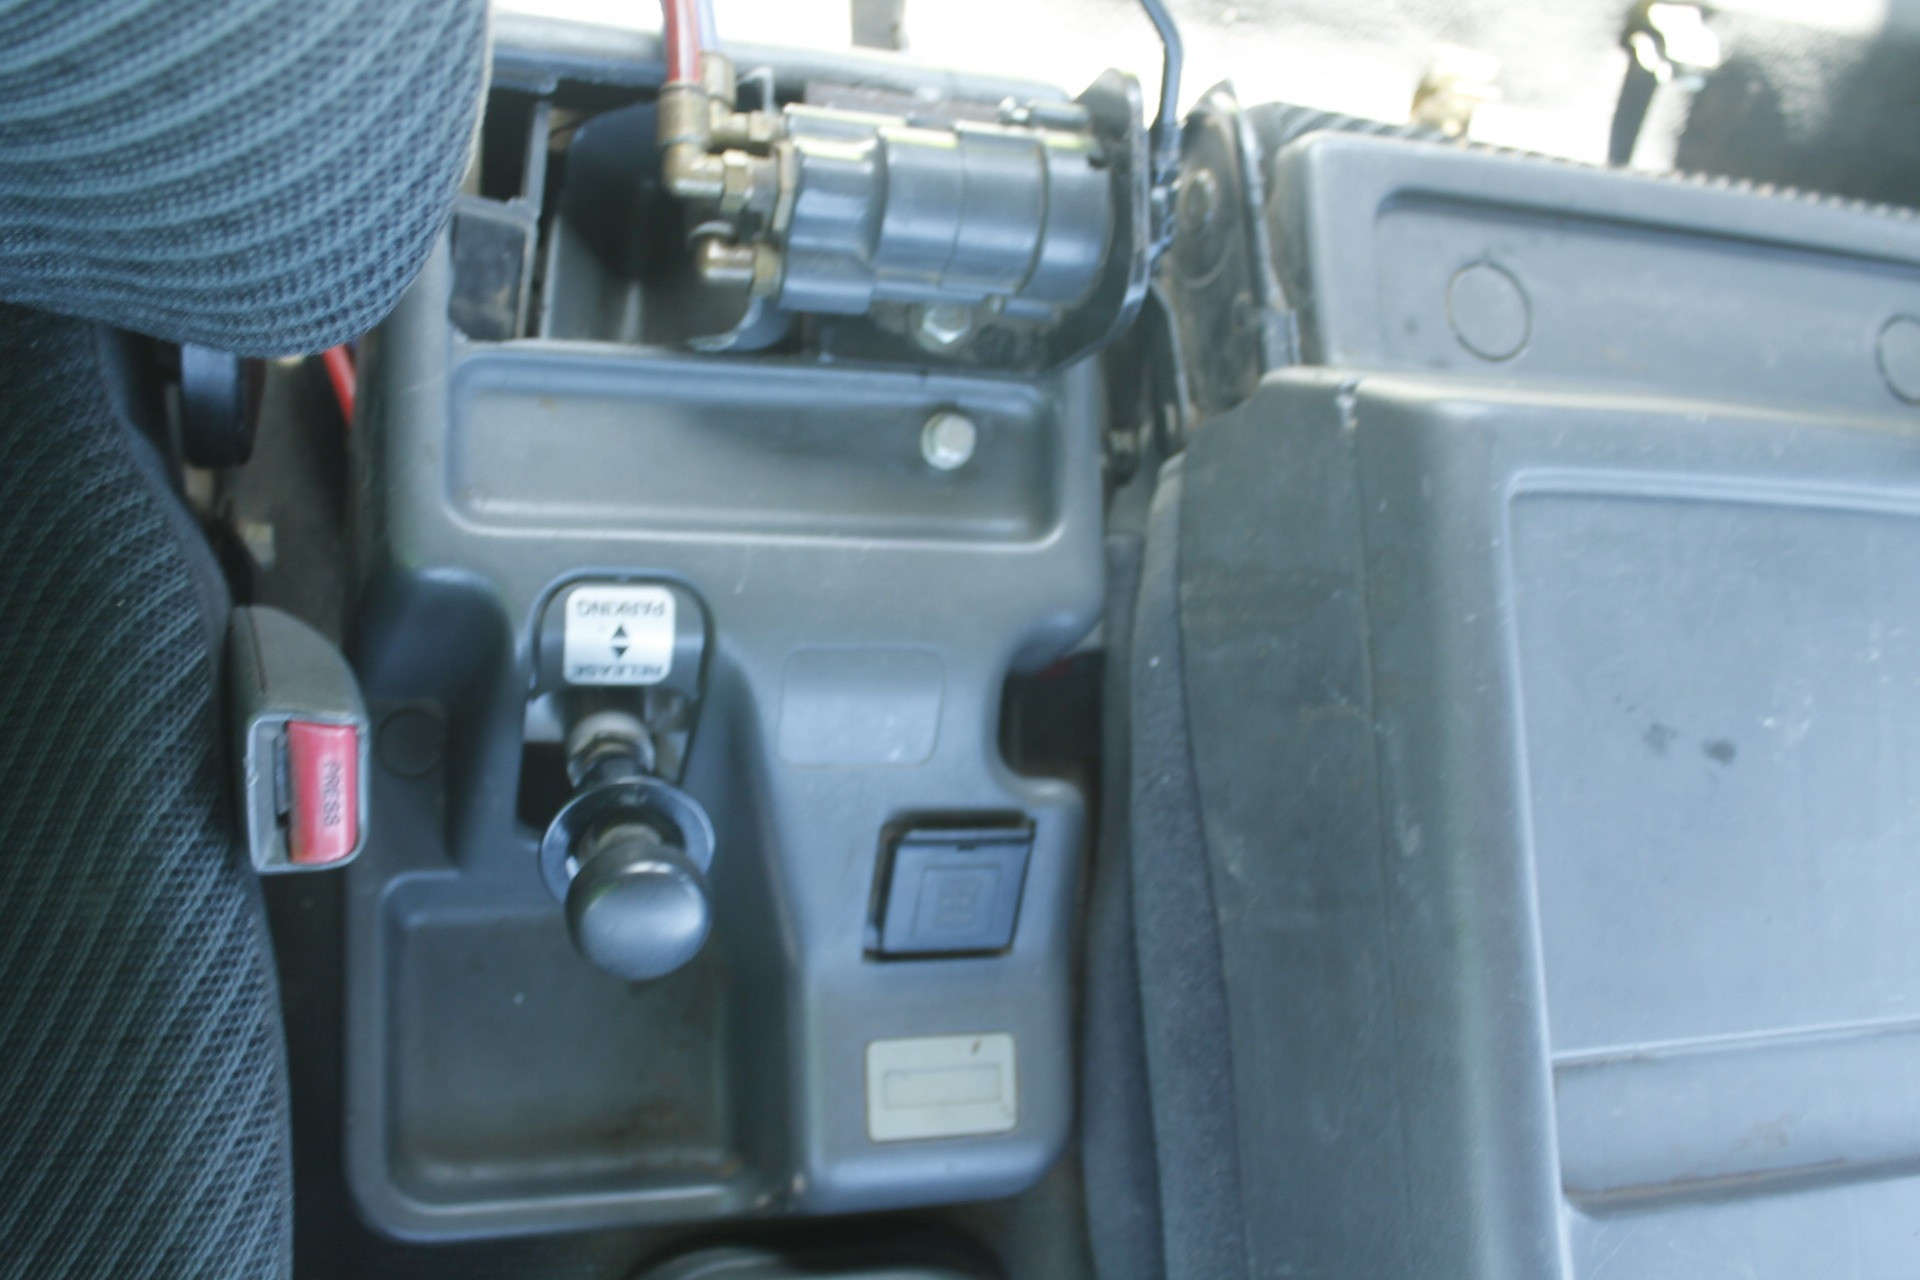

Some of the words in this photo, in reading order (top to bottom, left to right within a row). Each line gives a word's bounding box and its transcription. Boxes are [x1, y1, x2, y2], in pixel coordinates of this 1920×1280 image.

[576, 600, 665, 617] PARKING
[573, 663, 663, 676] RELEASE
[322, 760, 341, 827] PRESS
